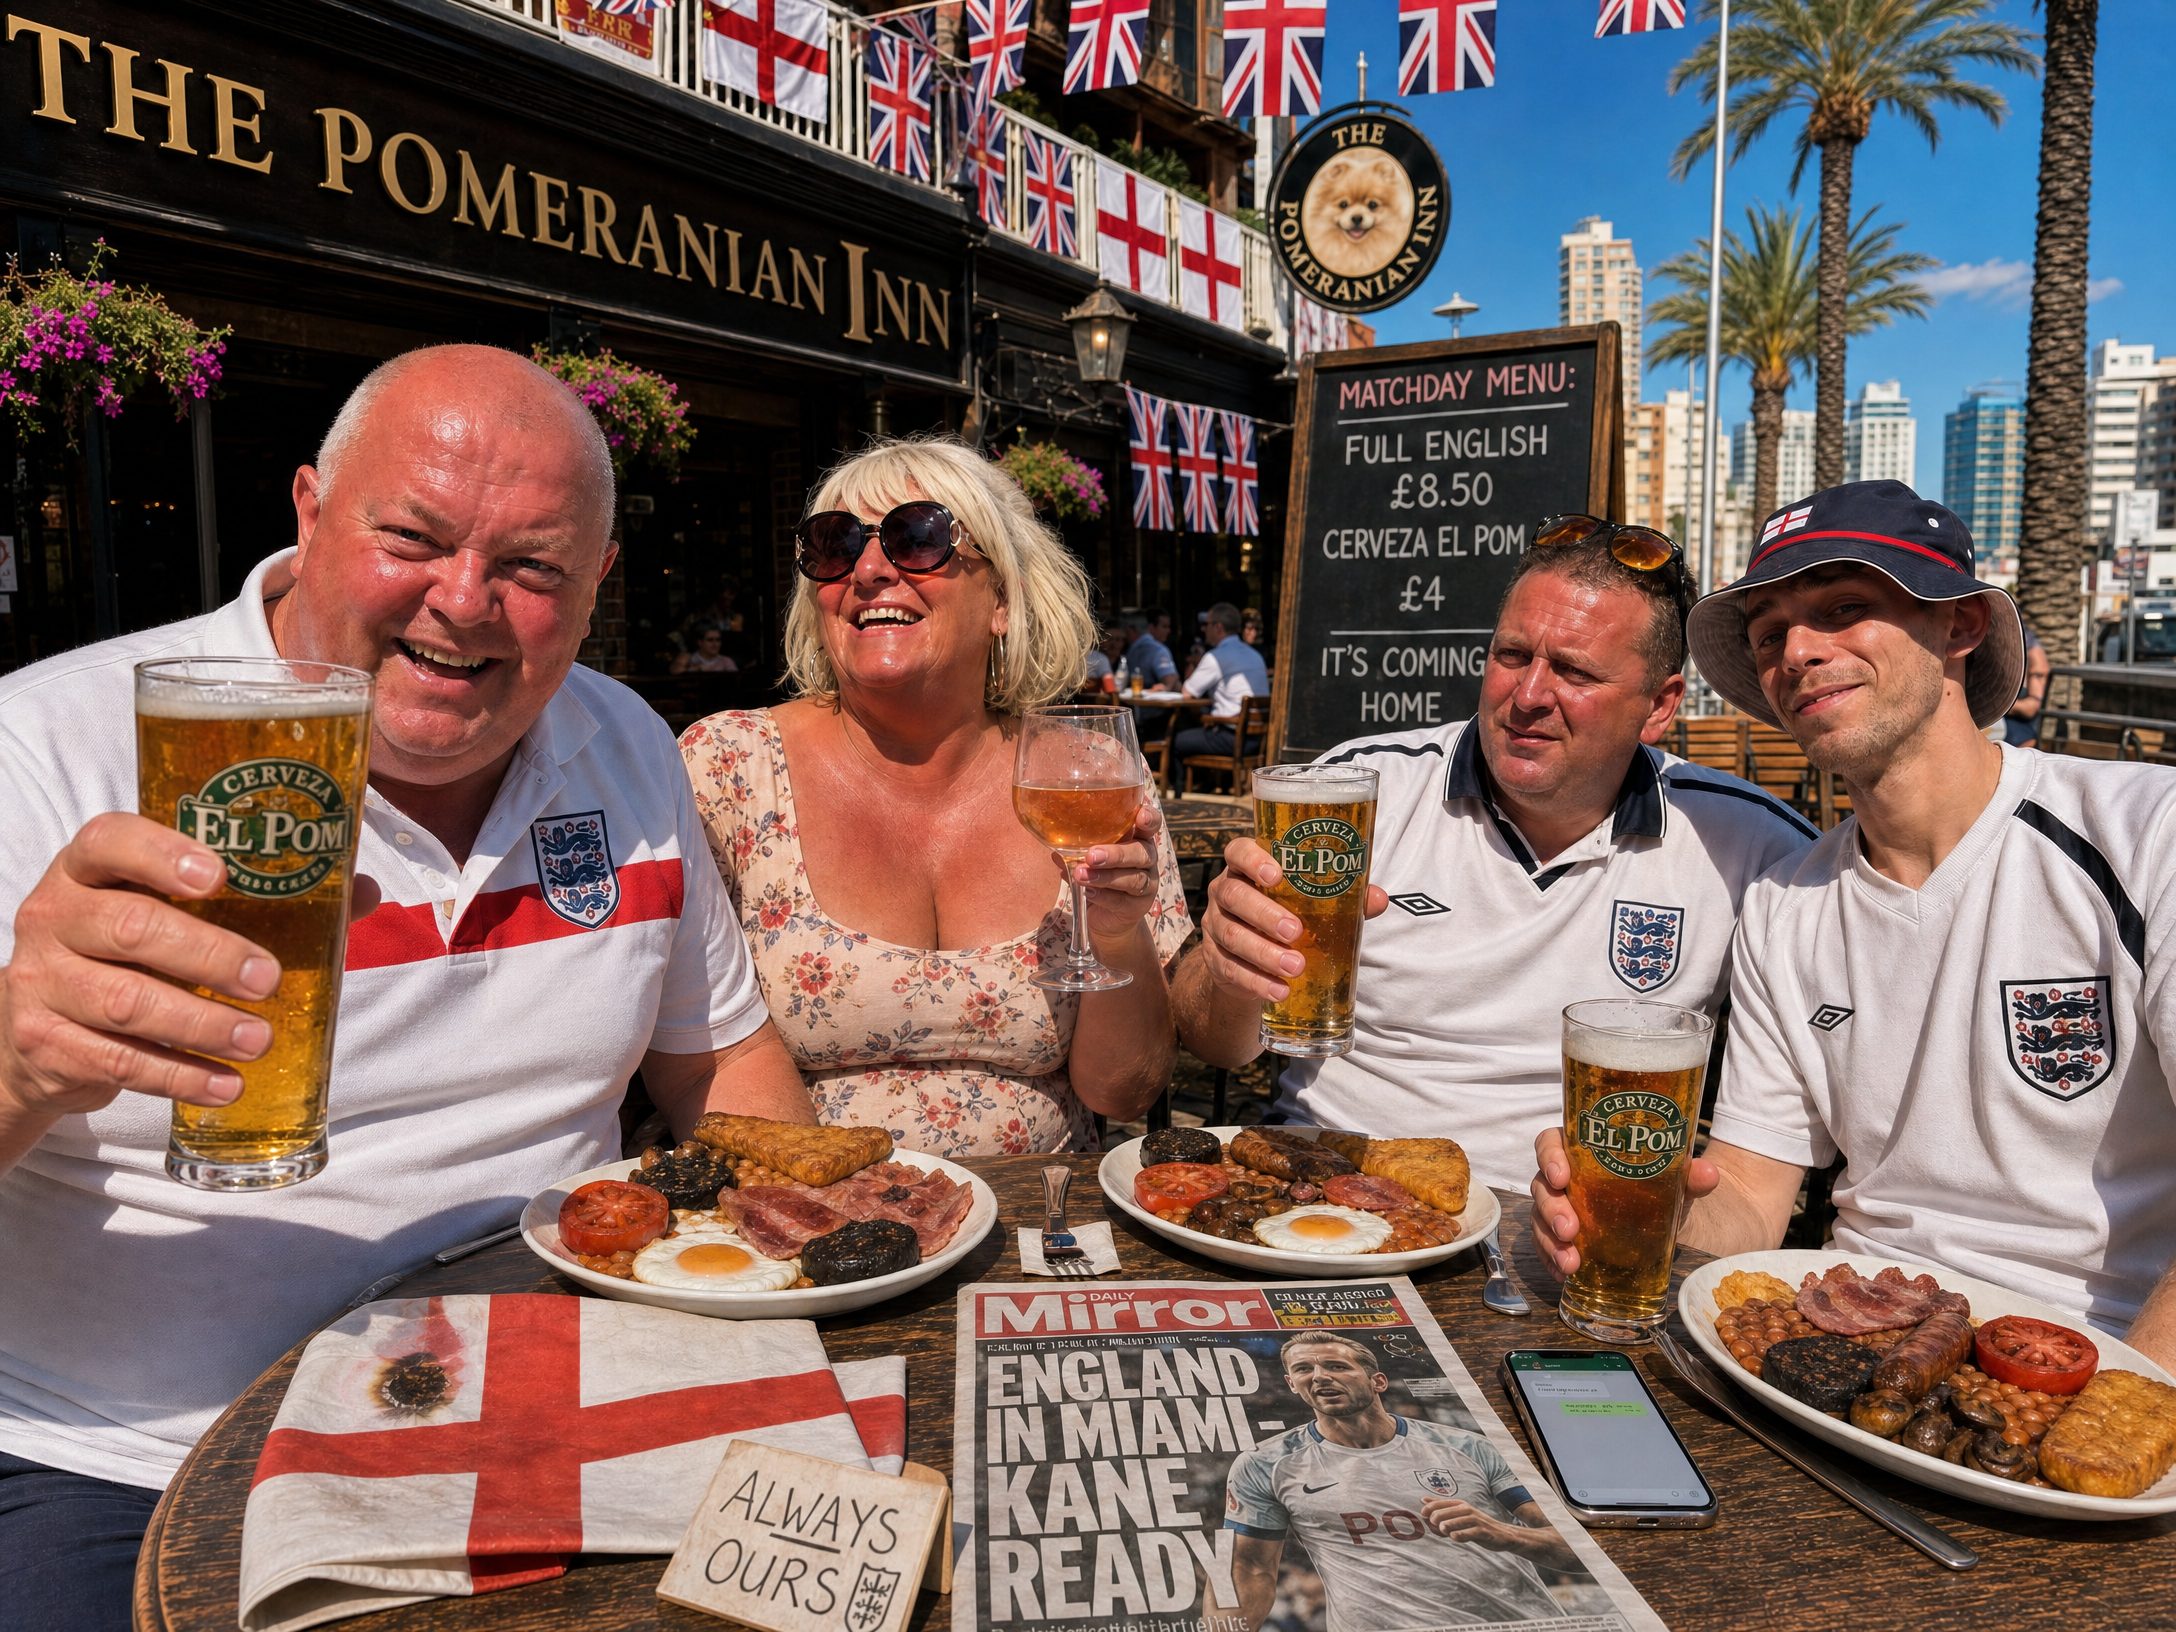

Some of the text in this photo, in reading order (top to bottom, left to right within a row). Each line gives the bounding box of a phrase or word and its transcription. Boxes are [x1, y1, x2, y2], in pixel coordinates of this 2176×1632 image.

[1332, 122, 1387, 149] THE
[5, 13, 951, 351] THE POMERANIAN INN
[1279, 184, 1438, 301] POMERANIAN INN
[1339, 361, 1577, 410] MATCHDAY MENU:
[1345, 424, 1548, 465] FULL ENGLISH
[1390, 472, 1494, 510] £8.50
[1322, 524, 1525, 560] CERVEZA EL POM
[1398, 575, 1446, 612] £4
[1321, 643, 1486, 677] IT'S COMING
[1360, 691, 1442, 723] HOME
[223, 765, 334, 804] CERVEZA
[194, 805, 346, 855] EL POM
[1293, 822, 1355, 842] CERVEZA
[1279, 846, 1363, 874] EL POM
[1603, 1095, 1675, 1119] CERVEZA
[1586, 1117, 1621, 1149] EL
[983, 1293, 1262, 1334] Mirror
[1089, 1292, 1136, 1302] DAILY
[987, 1346, 1260, 1406] ENGLAND
[986, 1405, 1047, 1464] IN
[719, 1470, 900, 1554] ALWAYS
[987, 1456, 1203, 1537] KANE
[704, 1539, 840, 1615] OURS
[989, 1528, 1237, 1622] READY
